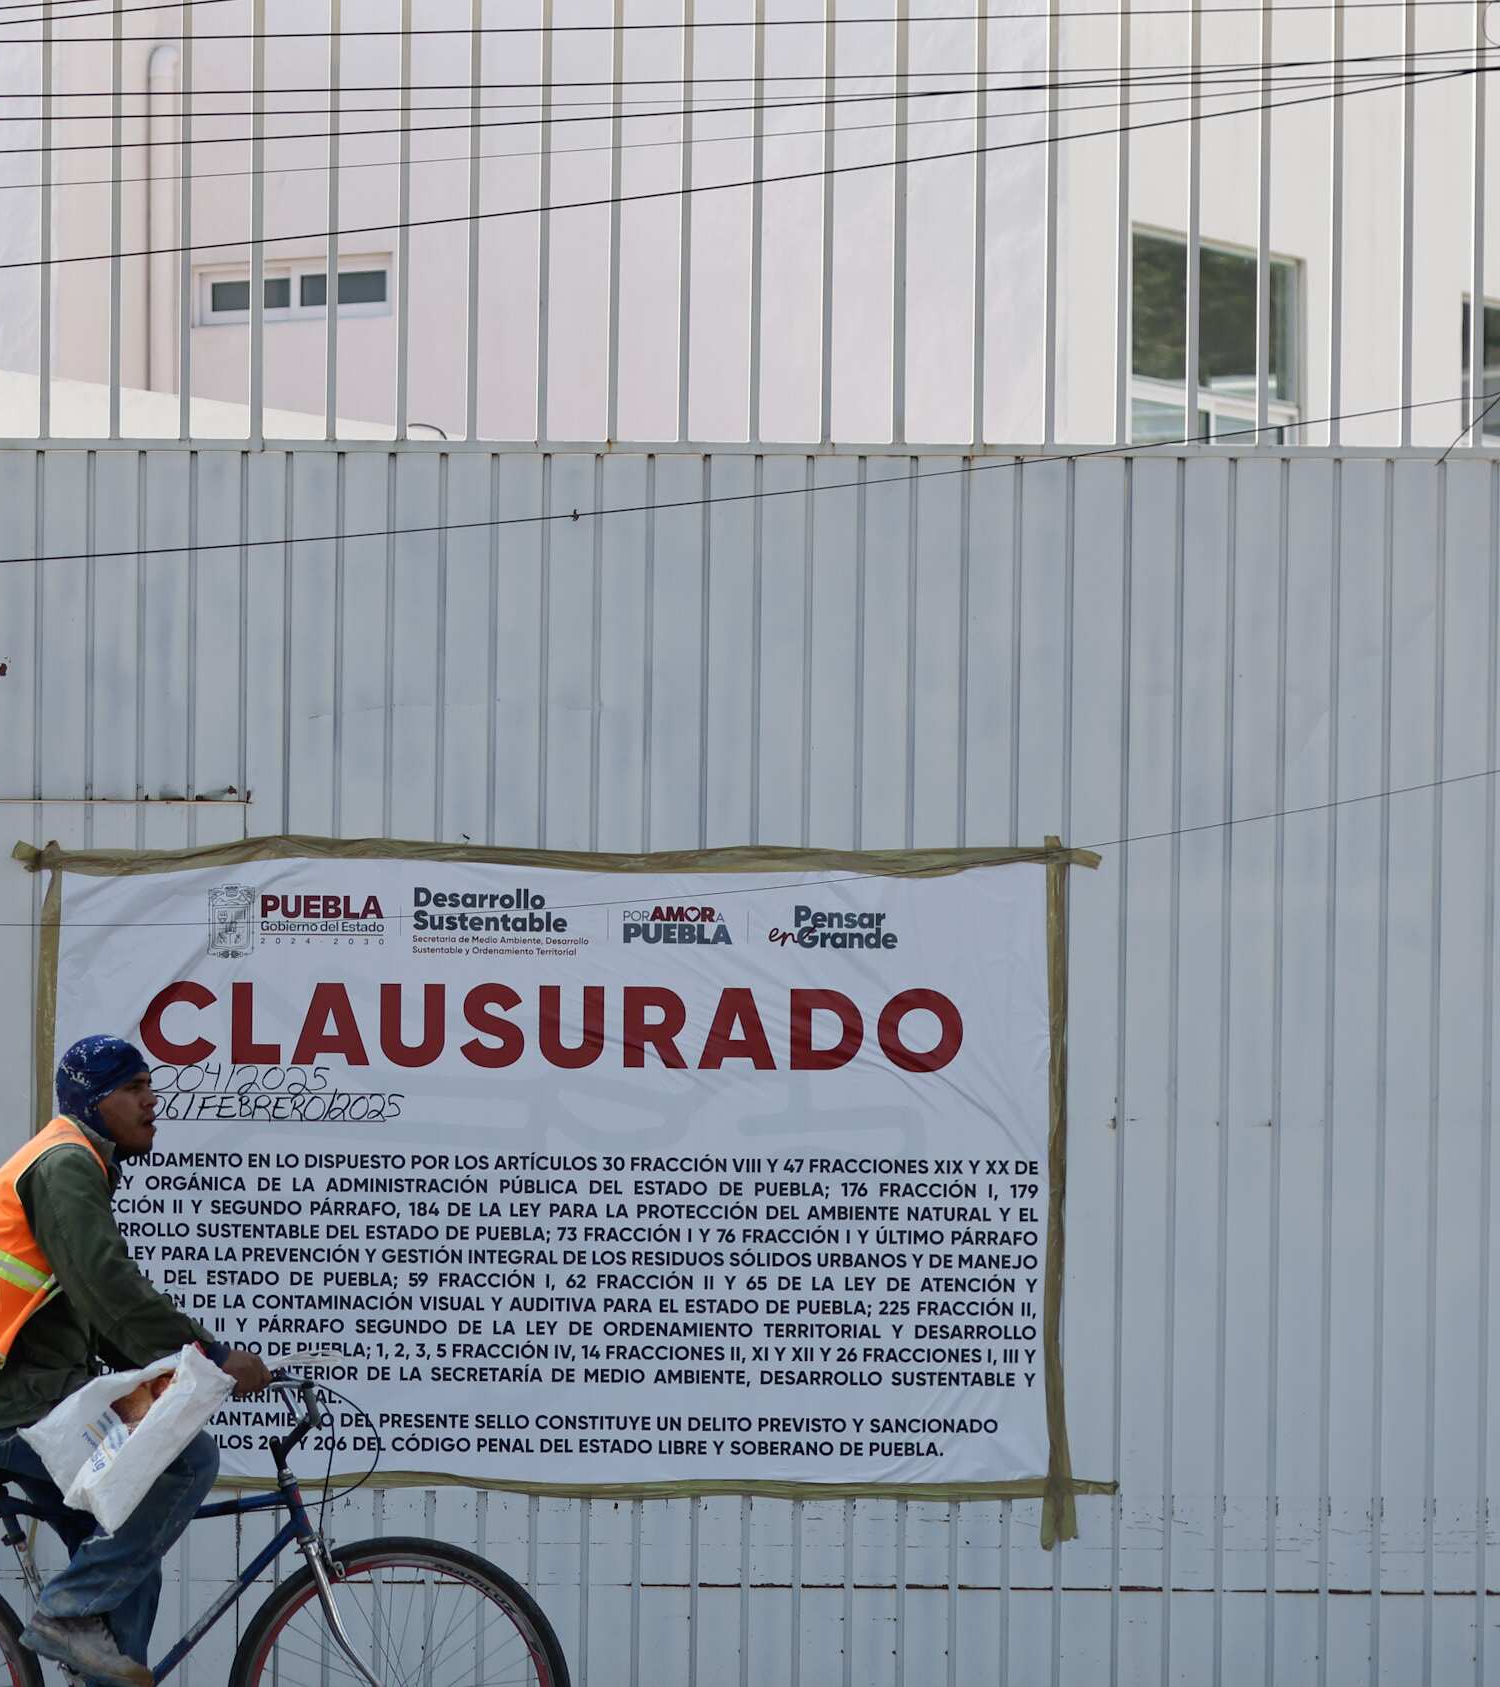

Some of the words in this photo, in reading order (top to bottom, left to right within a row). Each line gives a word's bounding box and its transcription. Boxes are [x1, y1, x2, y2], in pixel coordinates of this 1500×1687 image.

[261, 895, 384, 919] PUEBLA
[413, 887, 546, 911] Desarrollo
[261, 920, 317, 932] Gobierno
[320, 921, 338, 932] del
[342, 921, 385, 932] Estado
[413, 910, 568, 933] Sustentable
[623, 911, 649, 922] POR
[794, 905, 886, 929] Pensar
[472, 936, 498, 944] Medio
[500, 936, 543, 946] Ambiente,
[545, 937, 589, 945] Desarrollo
[623, 923, 733, 945] PUEBLA
[798, 924, 898, 949] Grande
[412, 945, 463, 954] Sustentable
[464, 948, 470, 956] y
[472, 946, 534, 955] Ordenamiento
[536, 947, 577, 956] Territorial
[138, 981, 963, 1074] CLAUSURADO
[126, 1152, 243, 1168] UNDAMENTO
[248, 1153, 270, 1168] EN
[276, 1154, 299, 1168] LO
[305, 1154, 405, 1169] DISPUESTO
[411, 1155, 449, 1169] POR
[455, 1155, 489, 1170] LOS
[494, 1152, 597, 1171] ARTÍCULOS
[603, 1157, 625, 1171] 30
[631, 1154, 727, 1172] FRACCIÓN
[732, 1158, 761, 1173] VIII
[766, 1159, 779, 1173] Y
[783, 1159, 804, 1173] 47
[809, 1159, 928, 1174] FRACCIONES
[934, 1160, 963, 1174] XIX
[969, 1160, 980, 1174] Y
[986, 1160, 1009, 1175] XX
[1015, 1161, 1038, 1175] DE
[367, 1366, 390, 1381] DE
[400, 1366, 422, 1381] LA
[431, 1364, 542, 1382] SECRETARÍA
[552, 1368, 575, 1383] DE
[584, 1368, 645, 1384] MEDIO
[653, 1369, 750, 1387] AMBIENTE,
[760, 1370, 882, 1386] DESARROLLO
[891, 1371, 1015, 1387] SUSTENTABLE
[1024, 1373, 1036, 1387] Y
[341, 1413, 372, 1428] DEL
[380, 1413, 469, 1428] PRESENTE
[475, 1414, 529, 1429] SELLO
[535, 1415, 651, 1431] CONSTITUYE
[657, 1416, 681, 1431] UN
[688, 1417, 752, 1432] DELITO
[758, 1417, 846, 1433] PREVISTO
[852, 1418, 864, 1432] Y
[870, 1418, 998, 1433] SANCIONADO
[314, 1436, 347, 1451] 206
[353, 1436, 386, 1452] DEL
[392, 1433, 470, 1452] CÓDIGO
[477, 1438, 534, 1453] PENAL
[540, 1439, 573, 1453] DEL
[579, 1439, 652, 1454] ESTADO
[659, 1440, 707, 1455] LIBRE
[713, 1441, 724, 1455] Y
[730, 1441, 834, 1456] SOBERANO
[840, 1442, 863, 1456] DE
[869, 1442, 943, 1456] PUEBLA.
